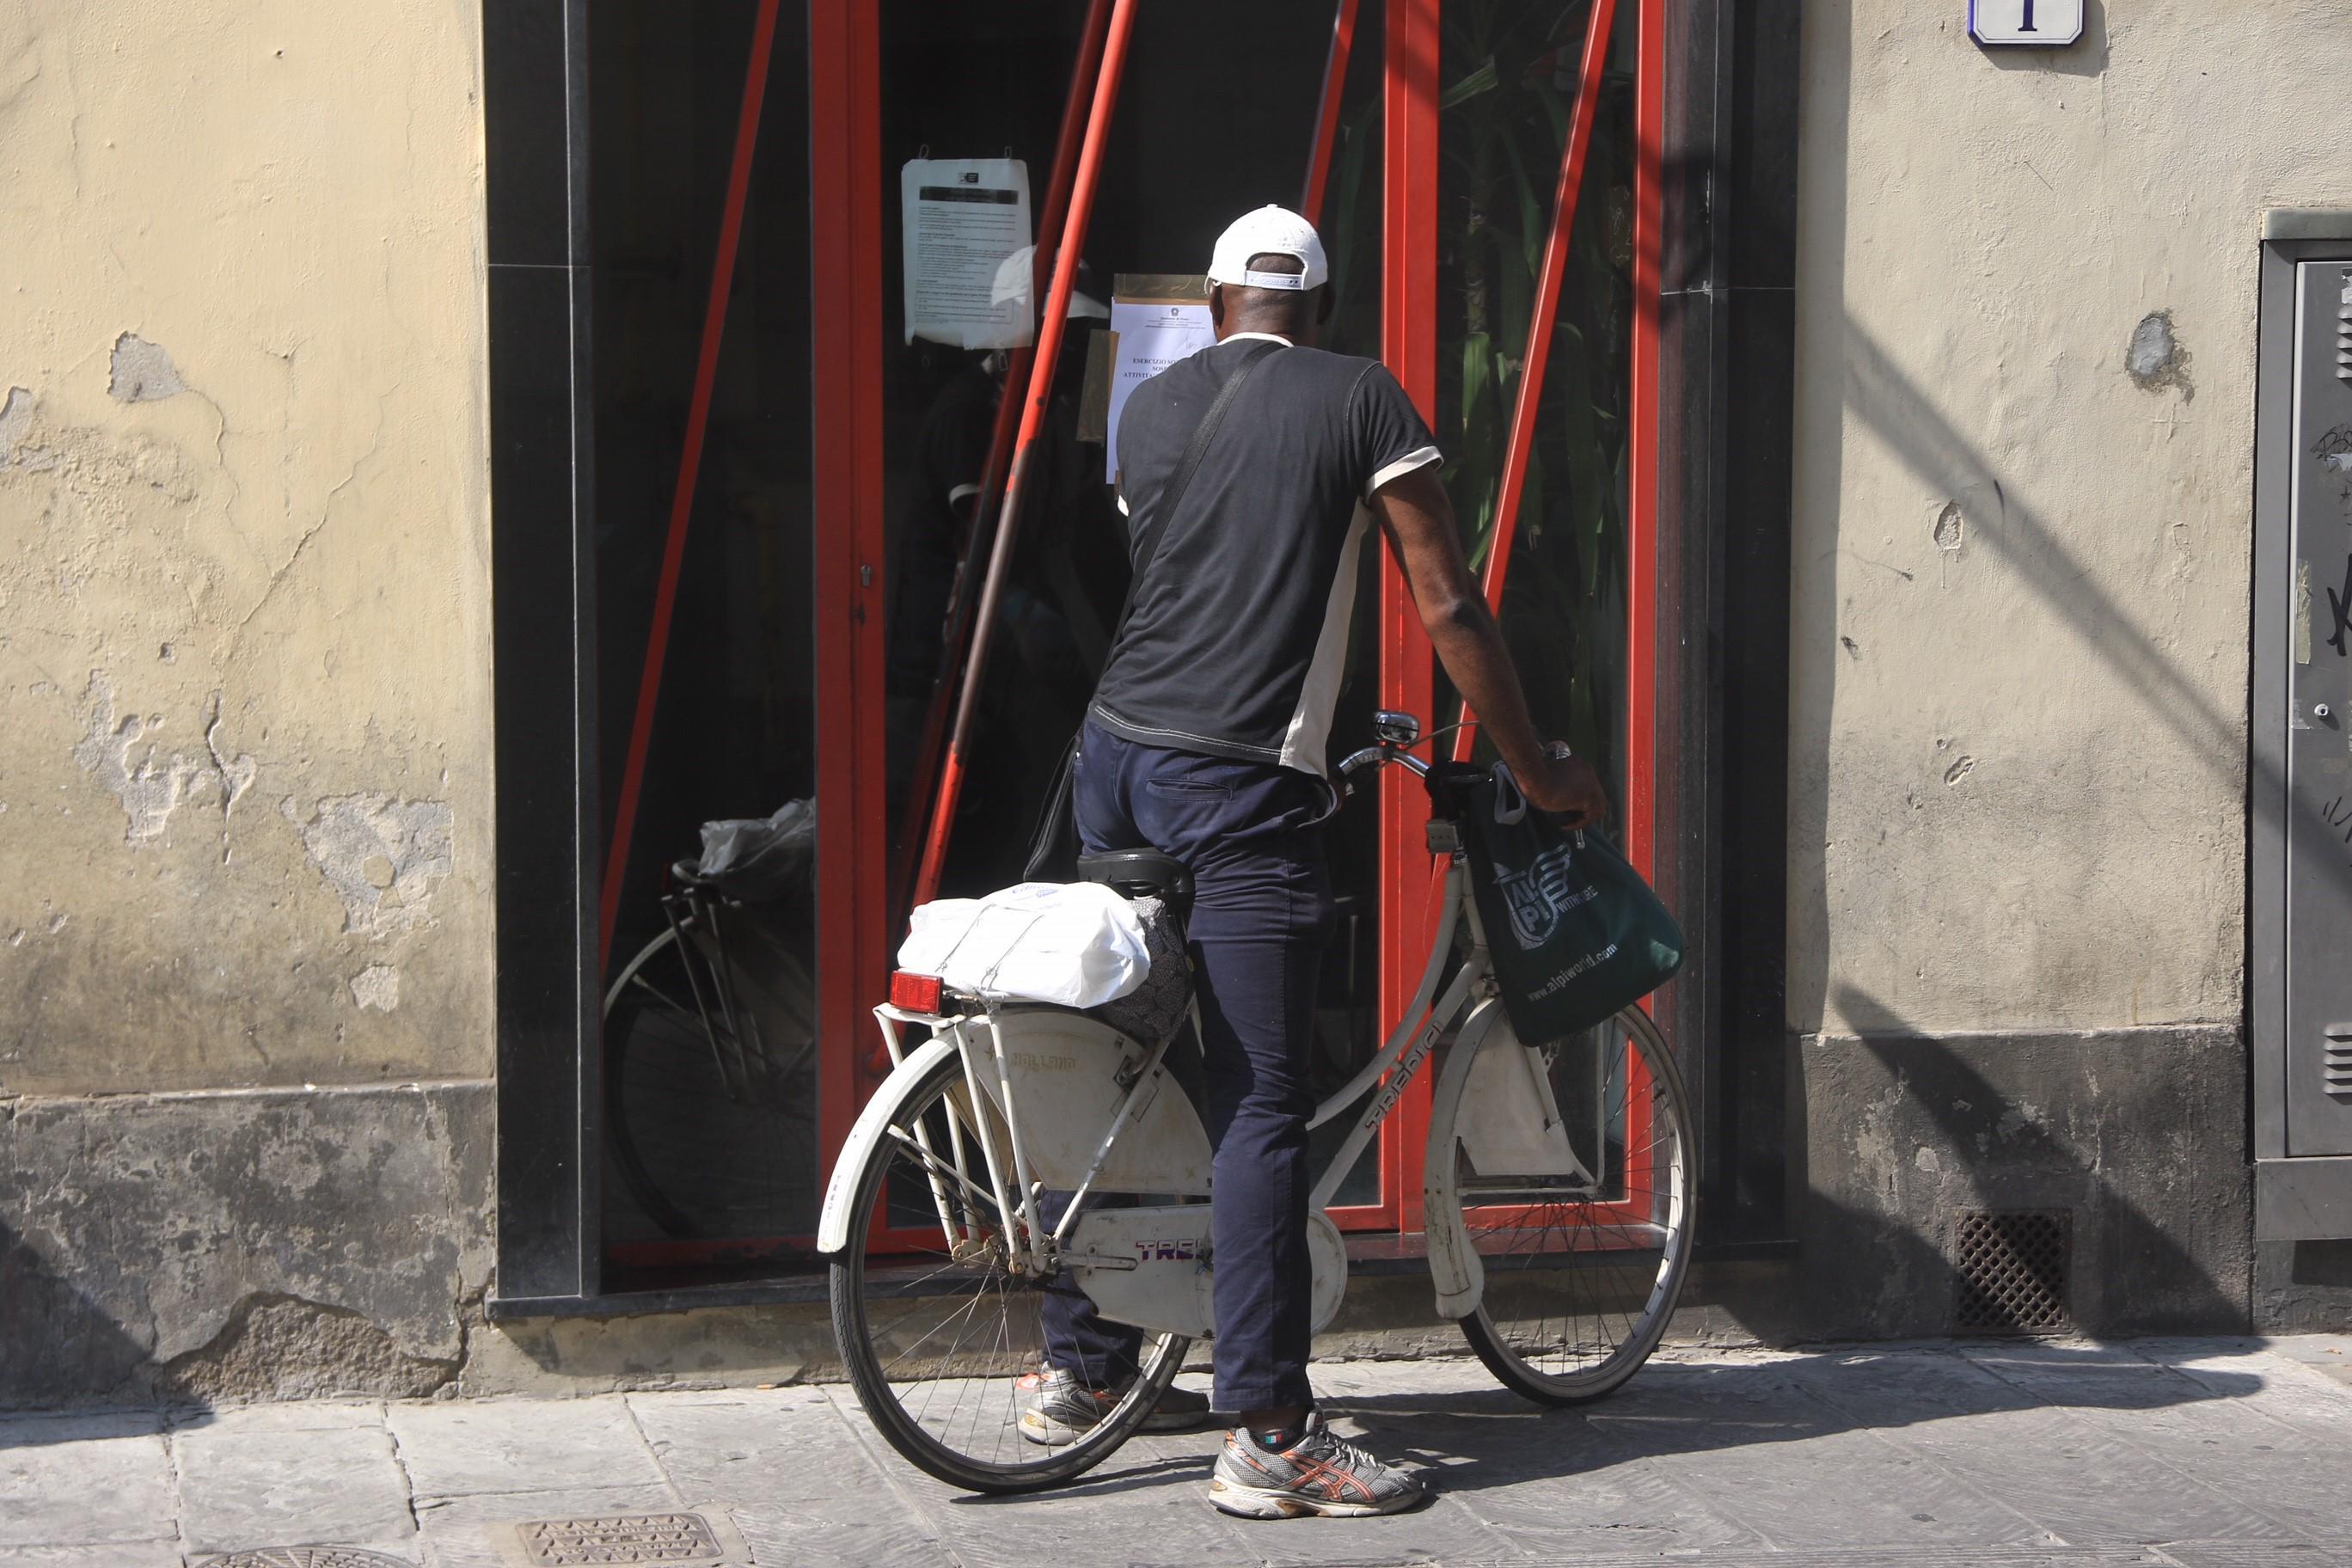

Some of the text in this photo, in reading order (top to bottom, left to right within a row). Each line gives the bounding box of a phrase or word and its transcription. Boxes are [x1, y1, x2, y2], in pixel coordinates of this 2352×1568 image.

[1527, 942, 1618, 1003] www.alpiworld.com
[1364, 1020, 1445, 1132] TREDICI
[1136, 1238, 1201, 1261] TRE
